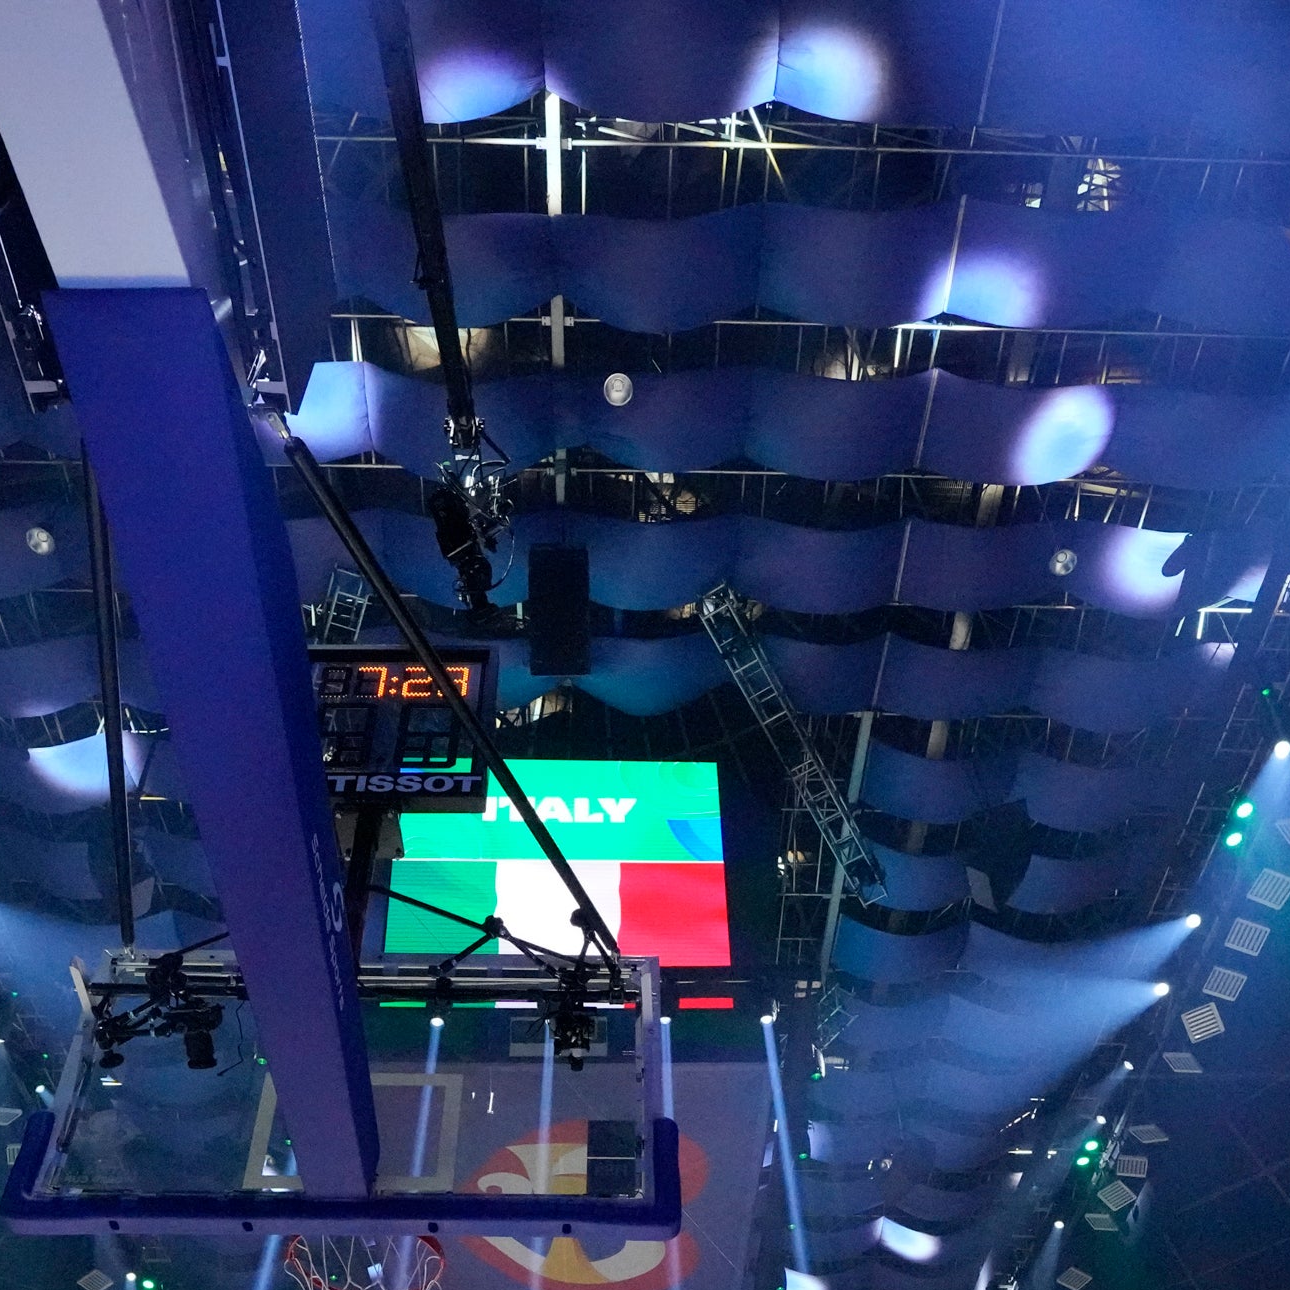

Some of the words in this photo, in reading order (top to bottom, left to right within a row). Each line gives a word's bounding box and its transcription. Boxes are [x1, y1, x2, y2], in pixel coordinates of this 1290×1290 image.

[358, 666, 470, 698] 7:23
[327, 775, 482, 793] TISSOT
[482, 796, 637, 823] ITALY
